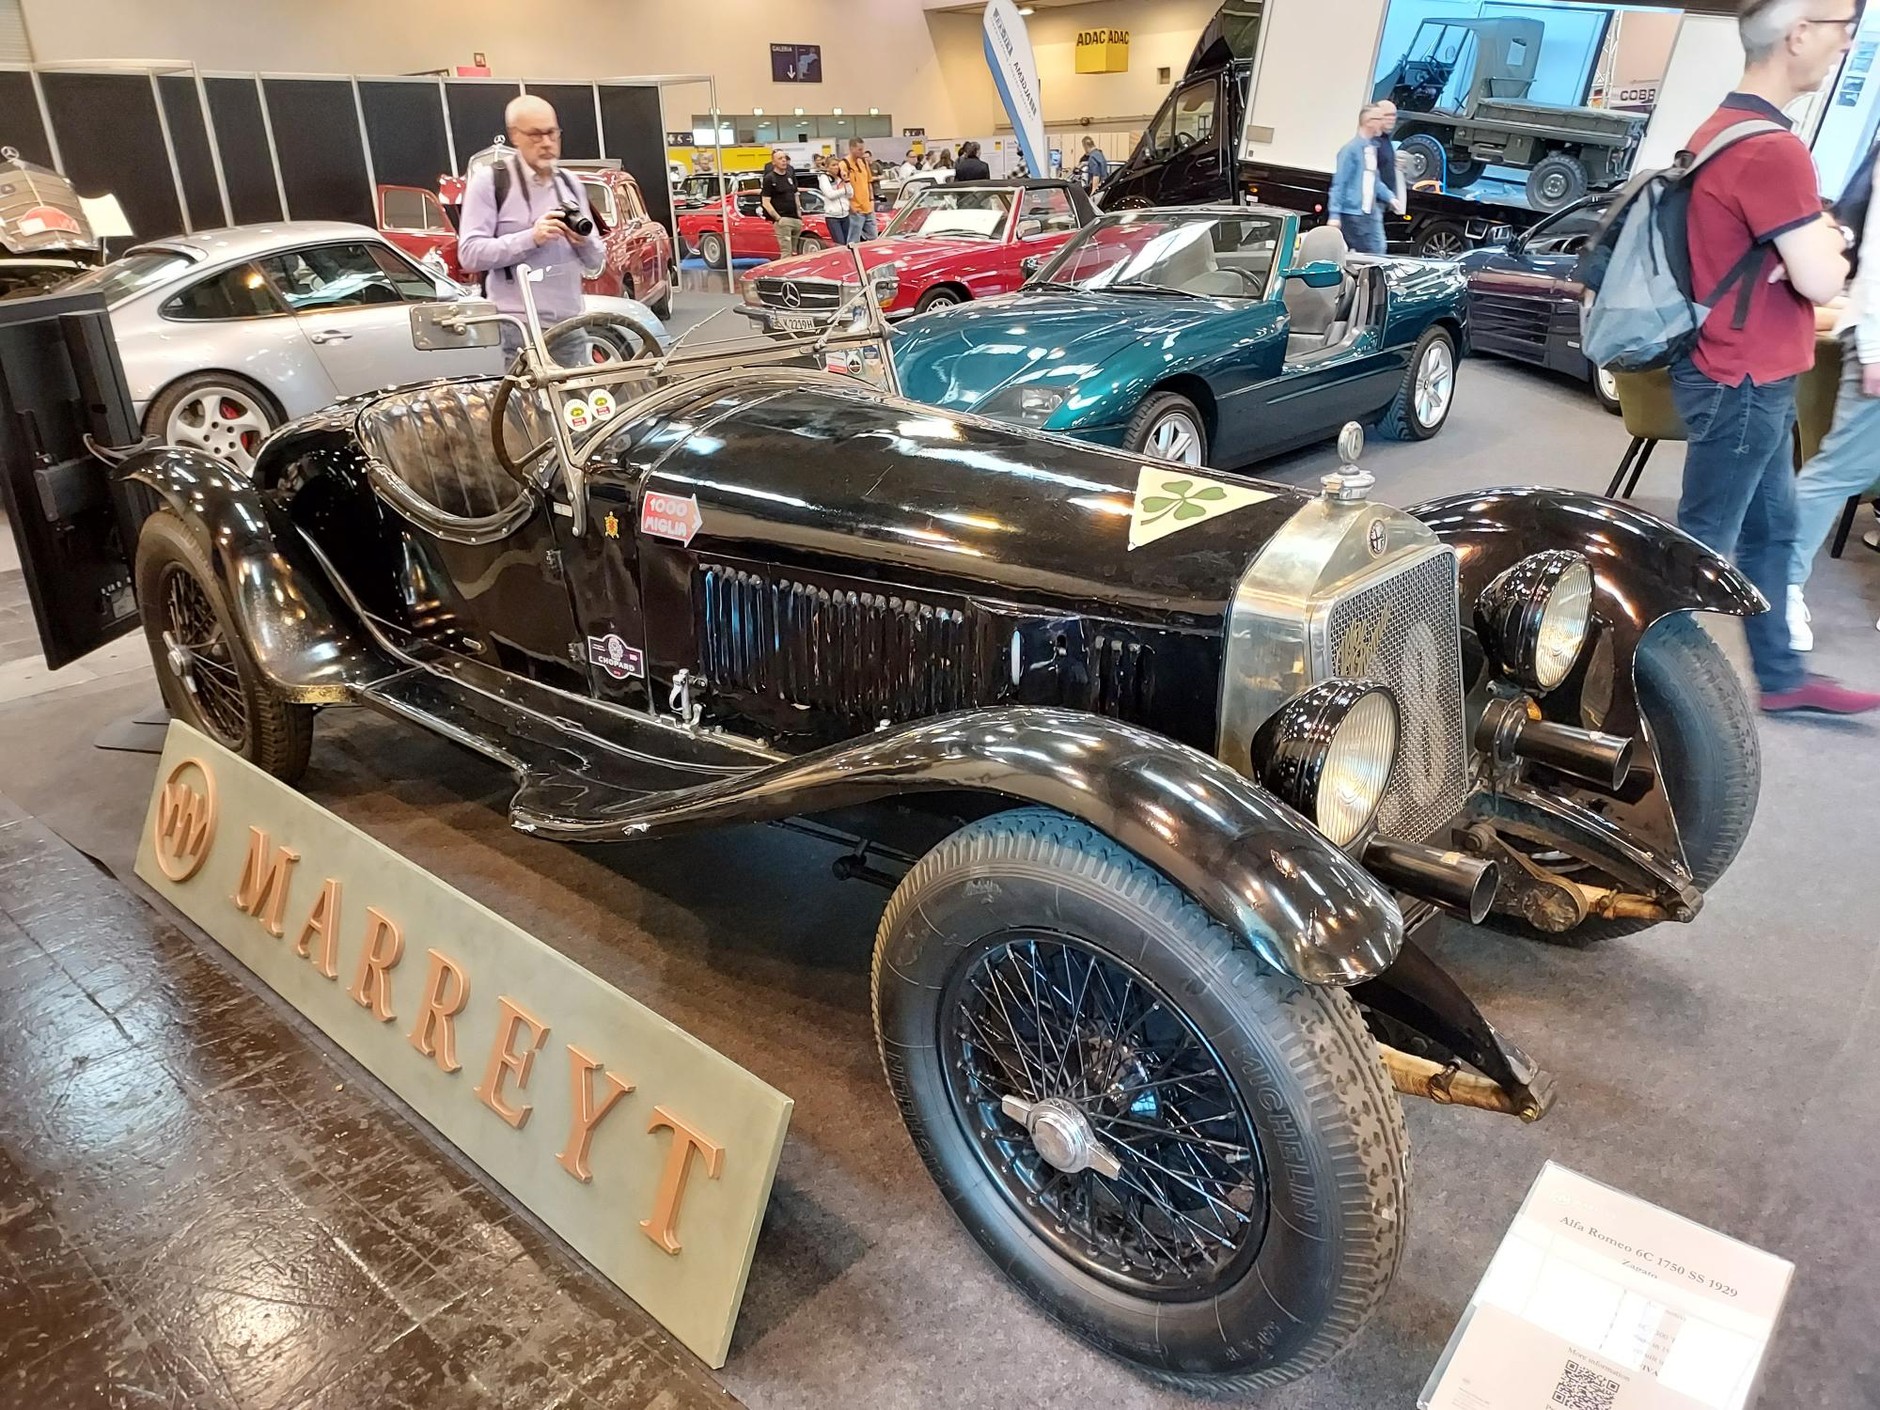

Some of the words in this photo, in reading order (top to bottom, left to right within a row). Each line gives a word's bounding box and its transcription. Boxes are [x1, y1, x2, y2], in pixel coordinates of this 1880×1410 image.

[1076, 30, 1106, 46] ADAC
[1107, 29, 1130, 45] ADAC
[650, 497, 688, 517] 1000
[644, 515, 687, 537] MIGLIA
[598, 655, 636, 672] CHOPARD
[229, 824, 726, 1256] MARREYT
[1231, 1045, 1319, 1223] MICHELIN
[1560, 1216, 1585, 1232] Alfa
[1588, 1227, 1632, 1252] Romeo
[1635, 1249, 1655, 1261] 6C
[1657, 1257, 1685, 1276] 1750
[1687, 1270, 1705, 1284] SS
[1708, 1279, 1738, 1298] 1929
